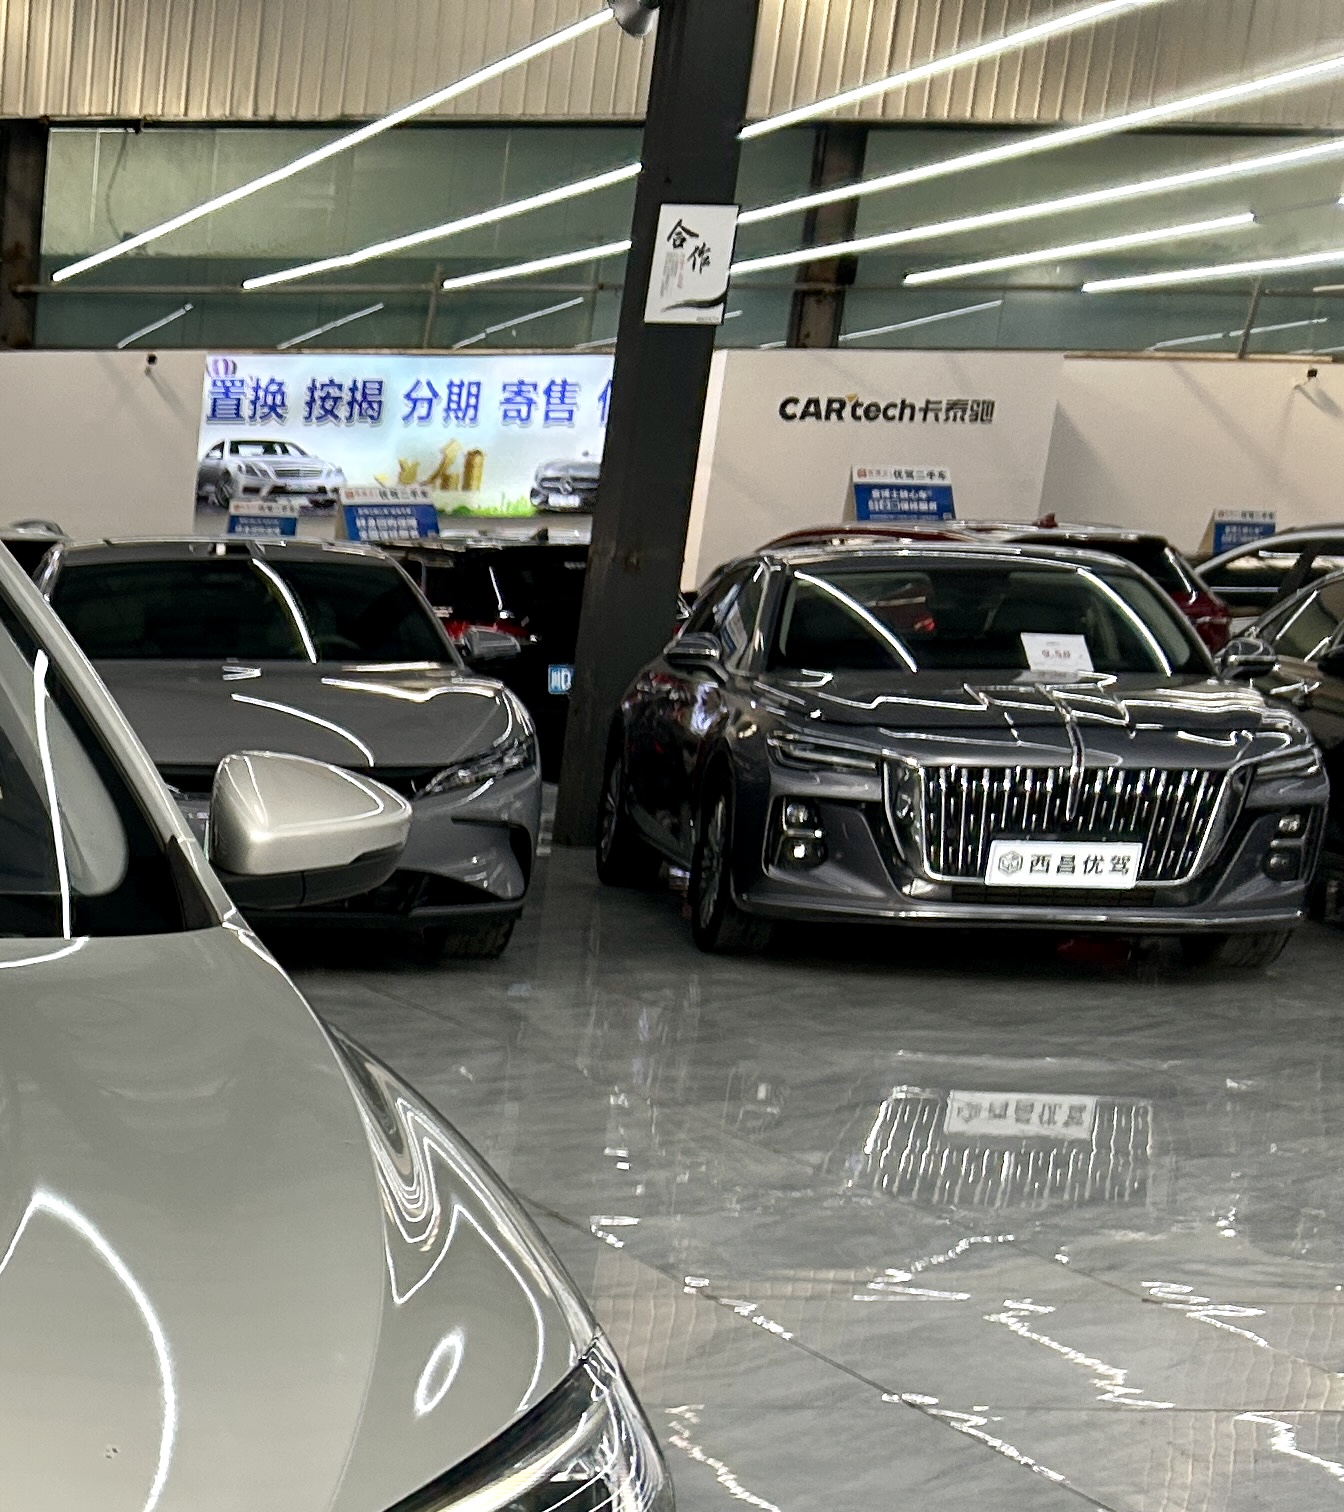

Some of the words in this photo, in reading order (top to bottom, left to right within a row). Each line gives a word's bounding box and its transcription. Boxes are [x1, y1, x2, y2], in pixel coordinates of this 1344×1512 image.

[666, 218, 712, 275] 合作
[206, 377, 288, 426] 置换
[303, 377, 384, 427] 按揭
[401, 378, 482, 427] 分期
[499, 378, 581, 427] 寄售
[1028, 853, 1132, 876] 西昌优驾
